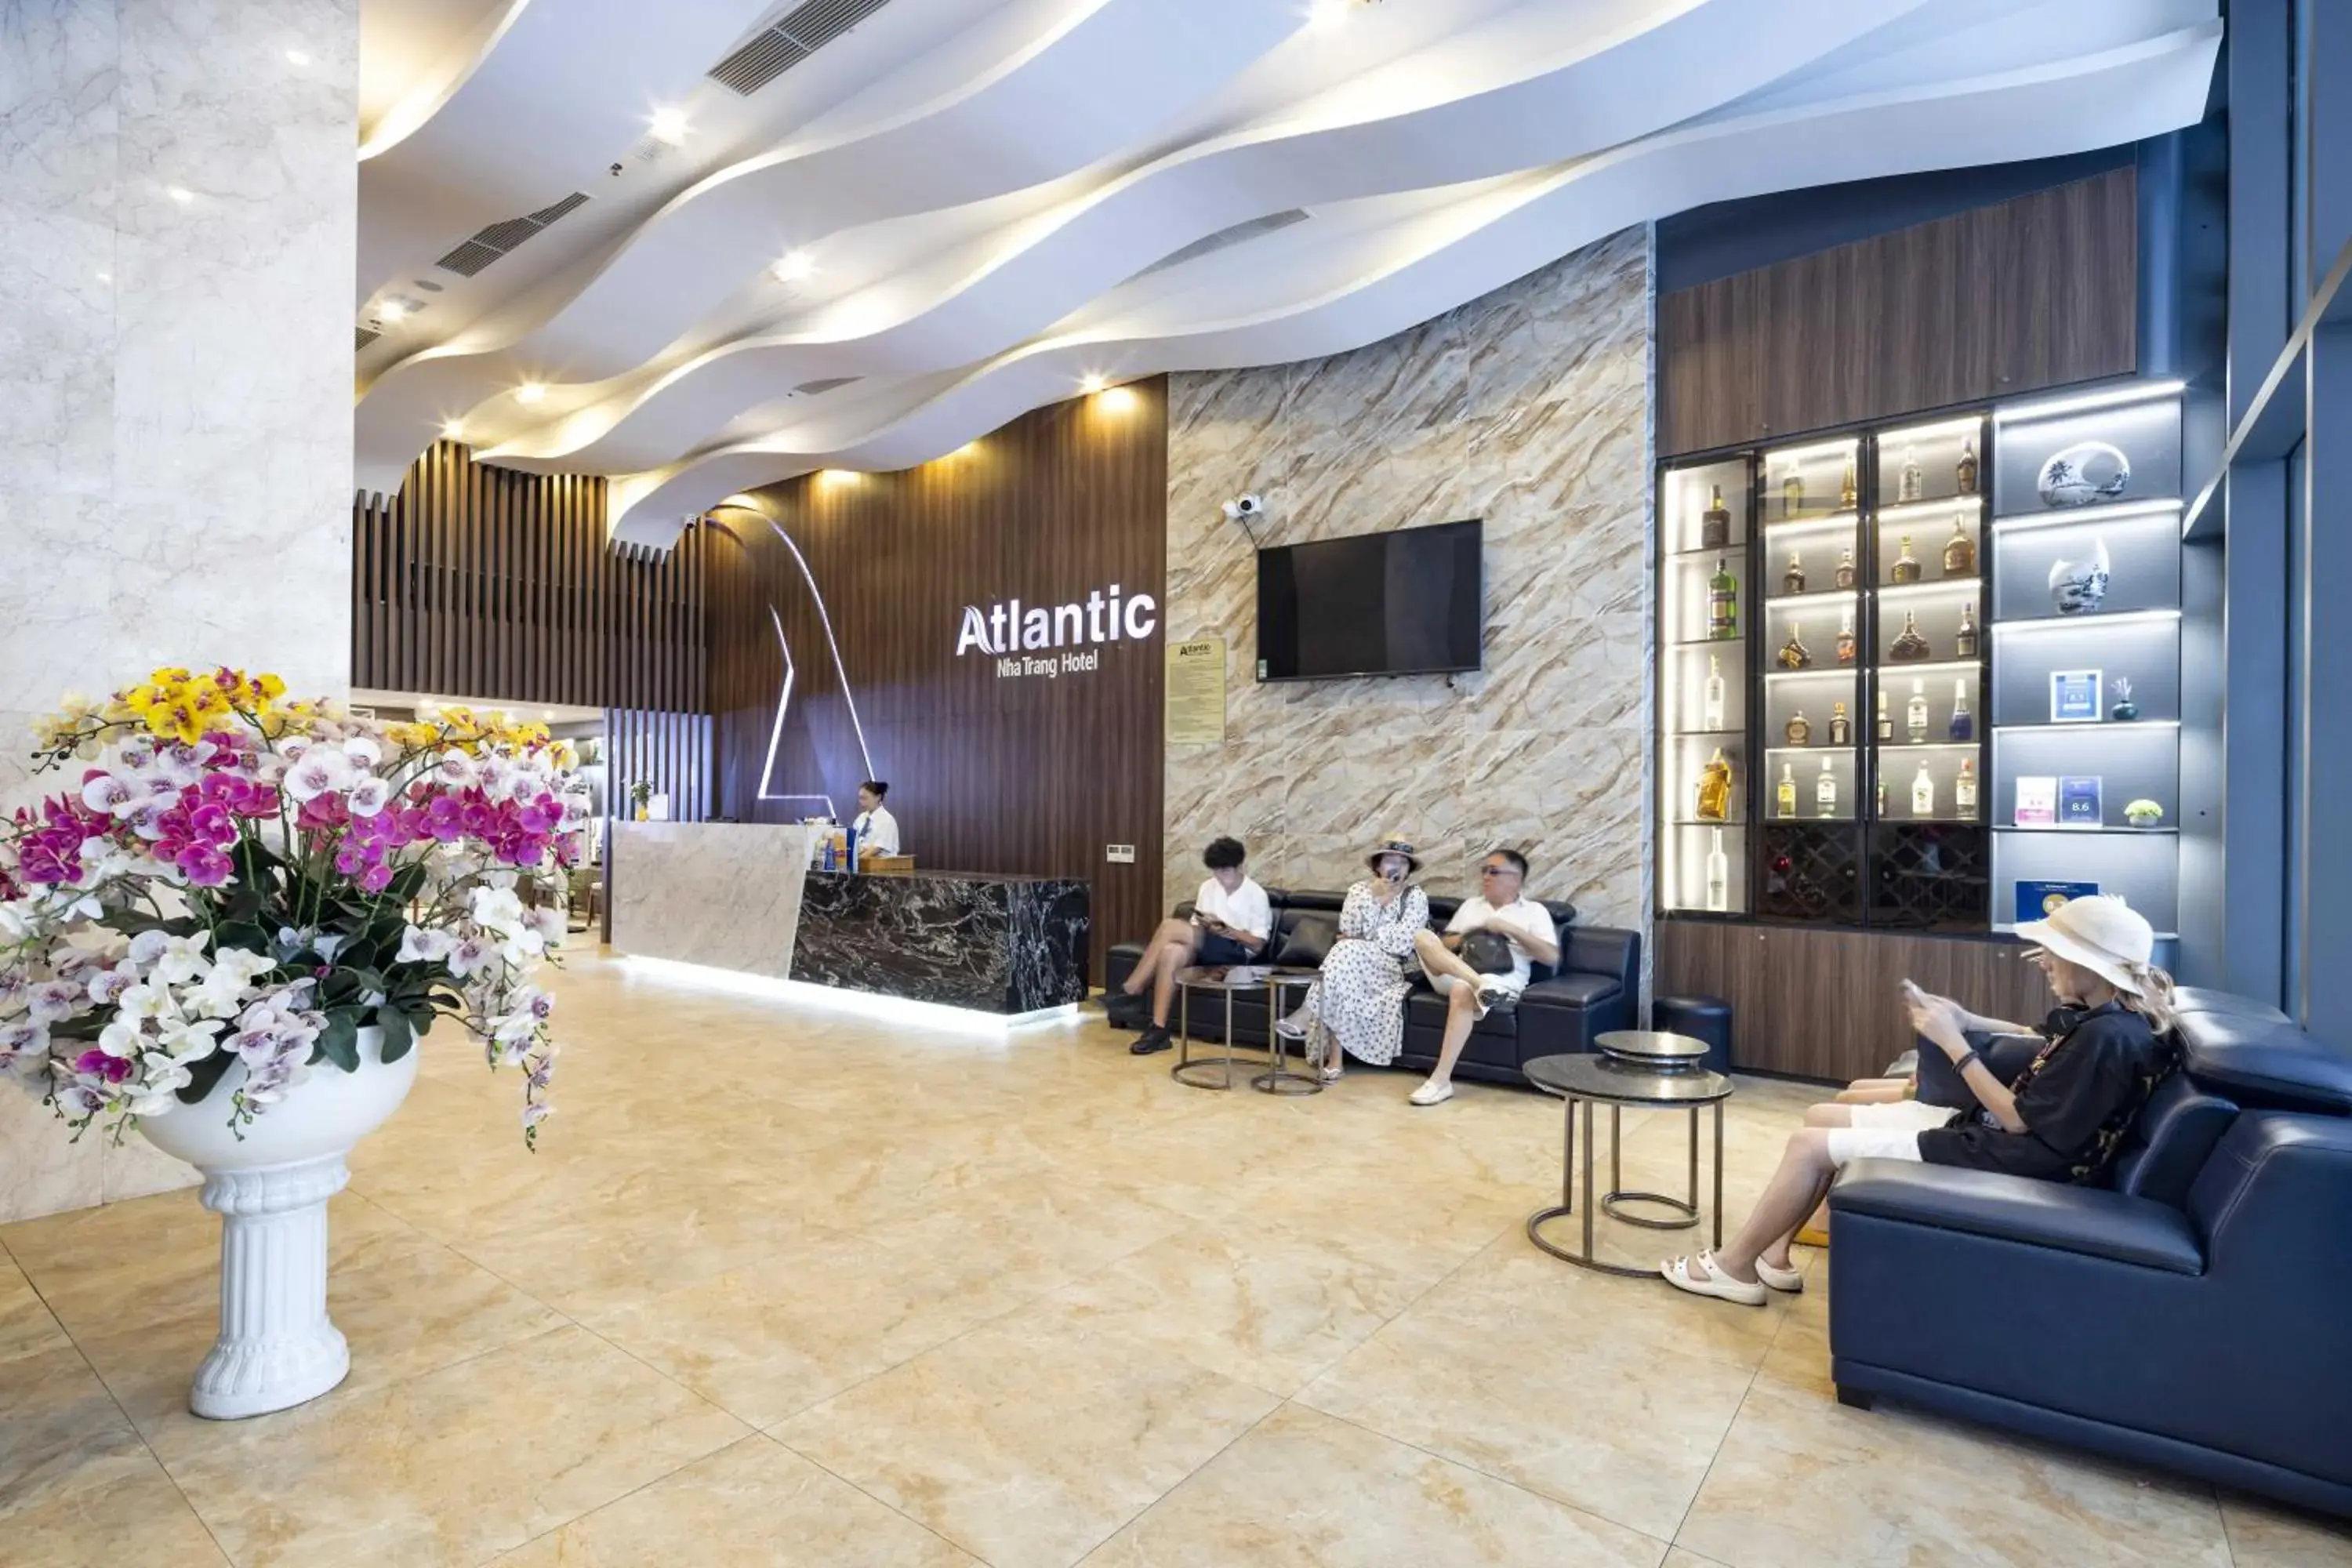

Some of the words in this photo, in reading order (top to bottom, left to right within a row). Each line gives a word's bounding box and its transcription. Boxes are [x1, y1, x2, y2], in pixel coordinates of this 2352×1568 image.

[956, 583, 1156, 656] Atlantic
[996, 657, 1022, 678] Nha
[1022, 655, 1058, 678] Trang
[1062, 648, 1098, 673] Hotel
[2072, 802, 2089, 811] 8.6
